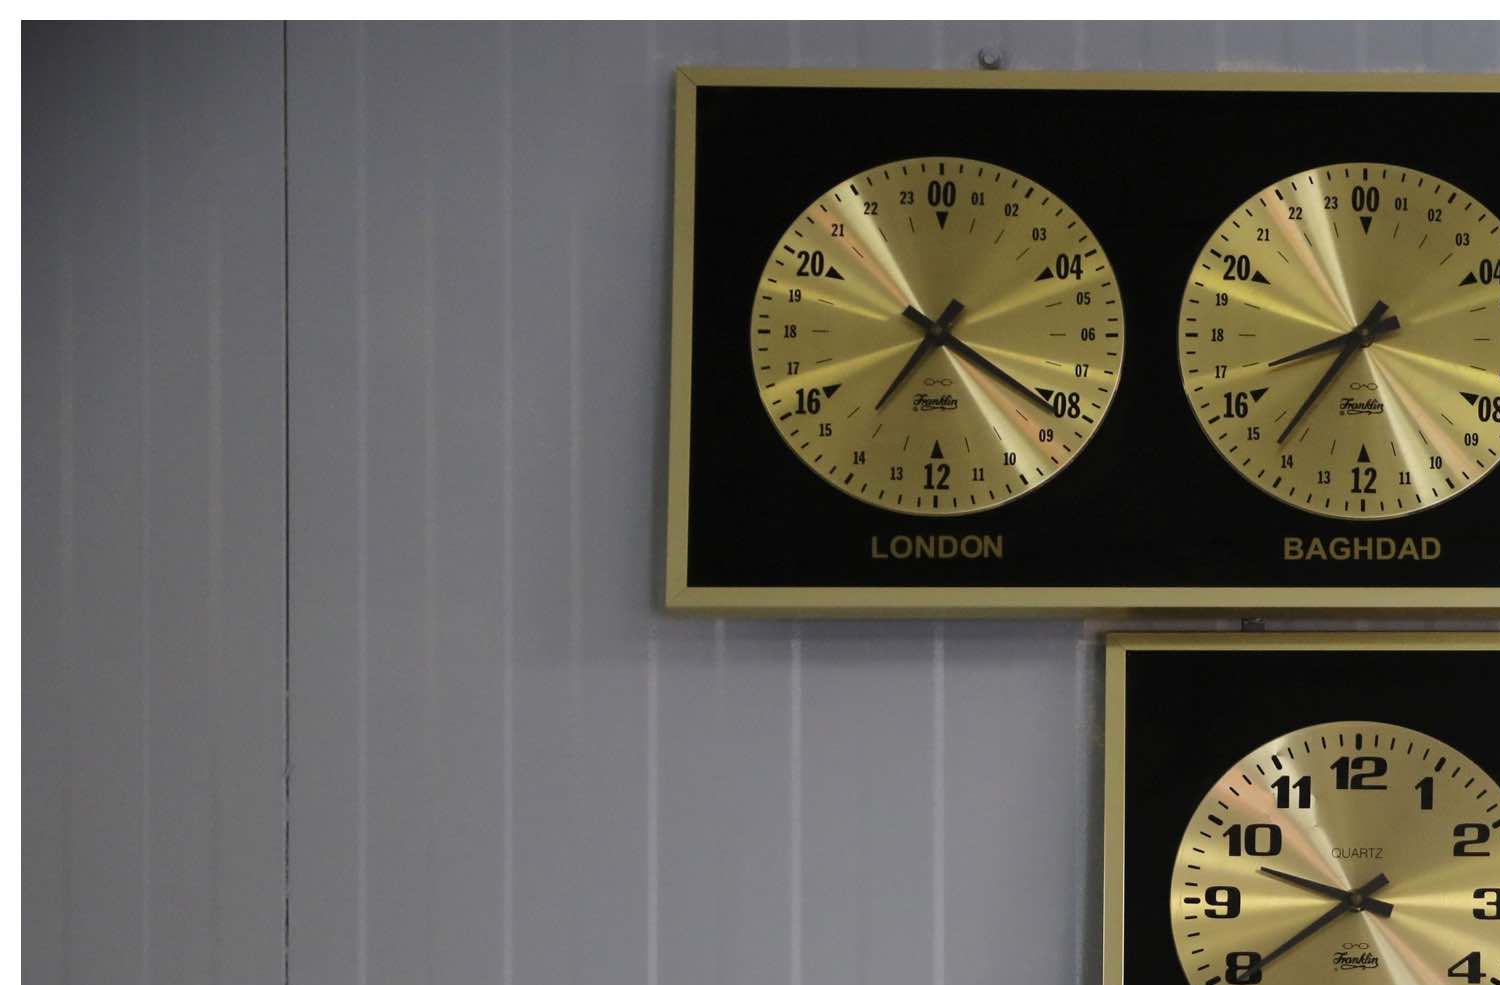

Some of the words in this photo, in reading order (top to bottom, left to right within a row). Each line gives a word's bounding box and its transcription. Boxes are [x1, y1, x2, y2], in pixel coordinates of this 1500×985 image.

[928, 181, 956, 207] 00
[1352, 186, 1379, 212] 00
[1428, 209, 1441, 222] 02
[797, 251, 824, 276] 20
[1056, 254, 1083, 279] 04
[1224, 255, 1250, 280] 20
[784, 325, 796, 338] 18
[1081, 328, 1095, 341] 06
[795, 389, 820, 414] 16
[912, 393, 958, 412] Franklin
[1053, 391, 1081, 418] 08
[1224, 392, 1248, 418] 16
[1340, 397, 1384, 415] Franklin
[924, 464, 950, 489] 12
[1351, 467, 1376, 493] 12
[872, 536, 1002, 558] LONDON
[1285, 538, 1440, 560] BAGHDAD
[1330, 757, 1387, 790] 12
[1271, 776, 1311, 808] 11
[1415, 777, 1433, 809] 1
[1223, 824, 1282, 856] 10
[1454, 823, 1490, 856] 2
[1331, 847, 1384, 859] QUARTZ
[1205, 886, 1240, 919] 9
[1225, 951, 1262, 985] 8
[1333, 952, 1379, 970] Franklin
[1448, 952, 1486, 984] 4
